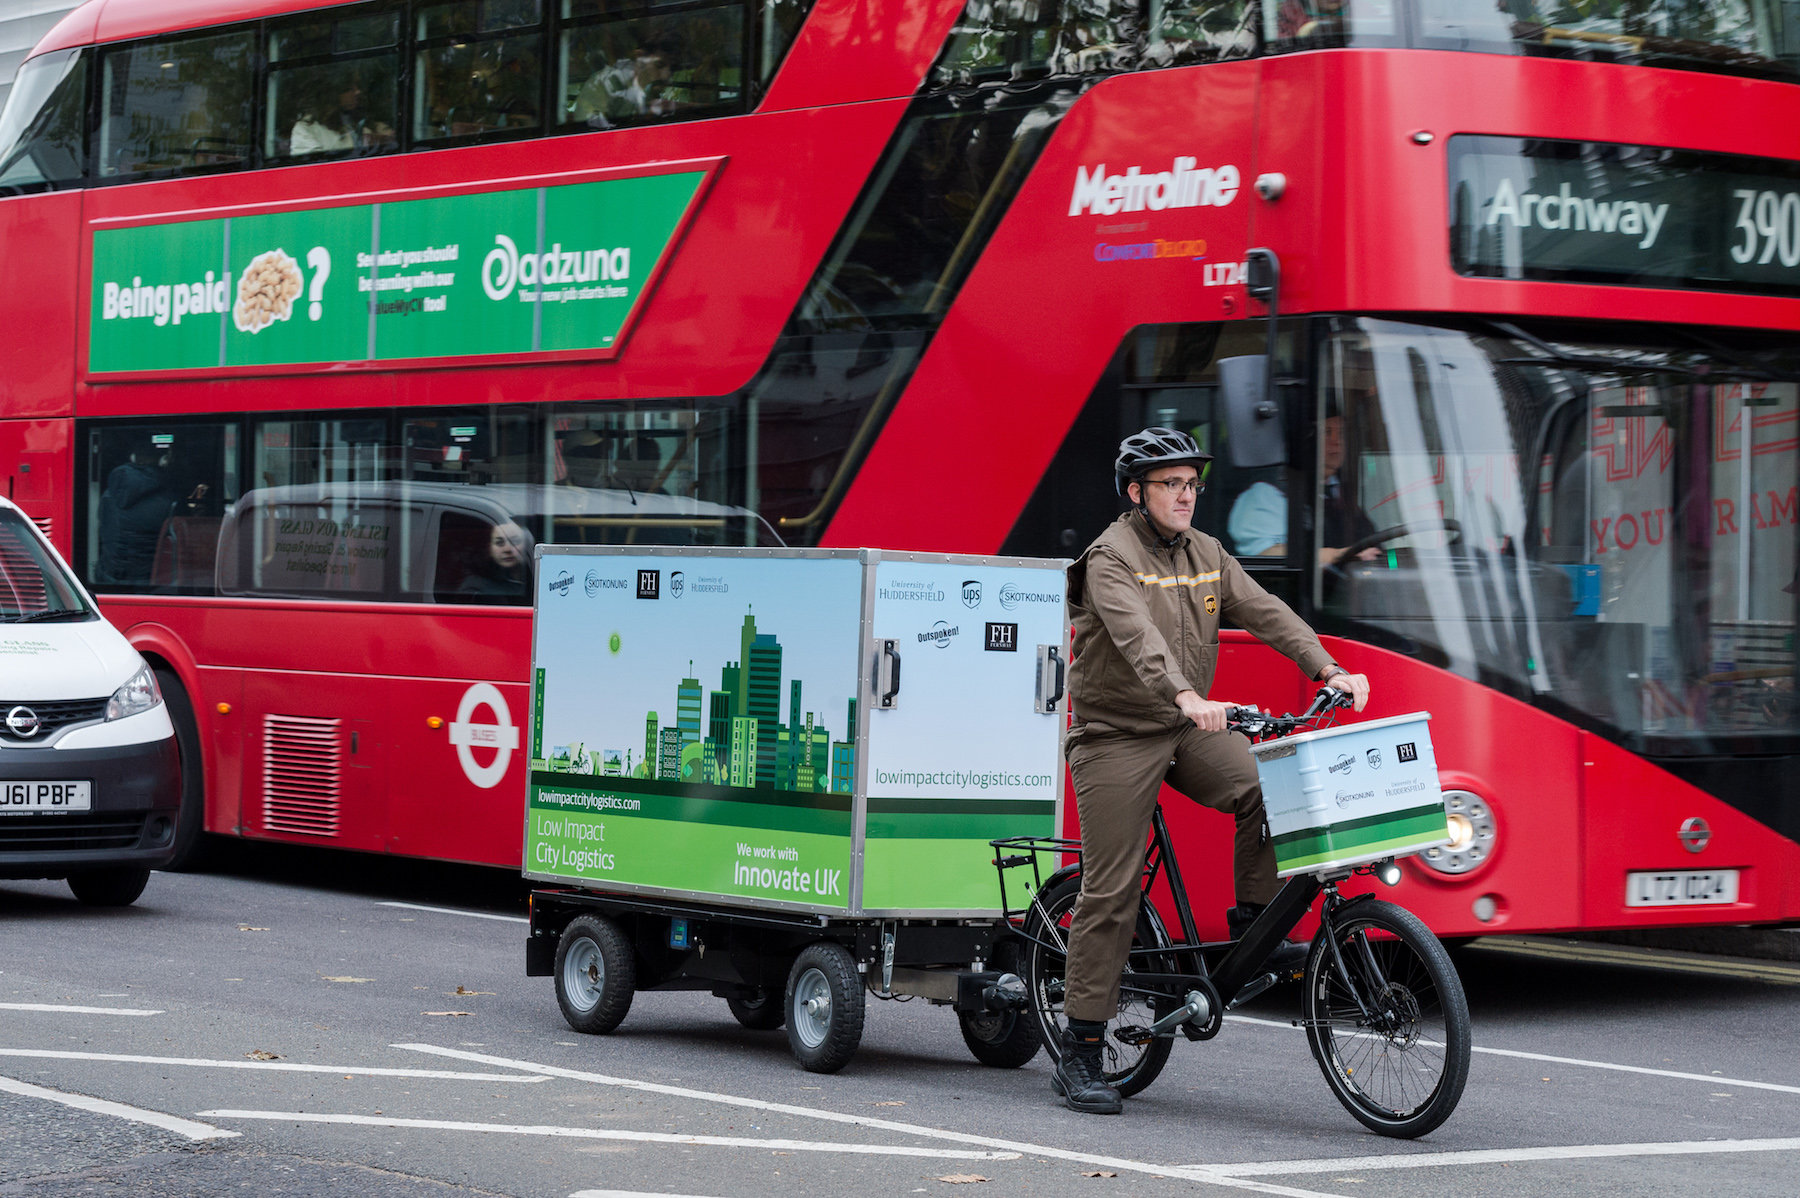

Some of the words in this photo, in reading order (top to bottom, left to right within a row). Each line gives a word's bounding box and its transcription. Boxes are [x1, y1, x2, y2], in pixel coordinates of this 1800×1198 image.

[1068, 156, 1240, 216] Metroline
[1486, 178, 1670, 250] Archway
[1730, 189, 1800, 268] 390
[518, 243, 631, 286] adzuna
[306, 246, 331, 322] ?
[103, 276, 171, 327] Being
[171, 270, 231, 325] paid
[1591, 506, 1674, 554] YOU
[641, 572, 656, 590] FH
[671, 579, 683, 595] ups
[891, 580, 925, 590] University
[926, 581, 935, 591] of
[879, 588, 945, 602] HUDDERSFIELD
[963, 589, 980, 604] ups
[1004, 592, 1061, 604] SKOTKONUNG
[917, 626, 960, 643] Outspoken!
[990, 625, 1013, 643] FH
[1368, 754, 1381, 766] ups
[1399, 744, 1414, 758] FH
[875, 768, 1052, 789] lowimpactcitylogistics.com
[37, 784, 77, 805] PBF
[537, 788, 641, 811] lowimpactcitylogistics.com
[537, 815, 562, 838] Low
[564, 817, 605, 844] Impact
[535, 841, 560, 869] City
[562, 844, 615, 872] Logistics
[736, 842, 752, 857] We
[753, 843, 776, 859] work
[777, 846, 799, 862] with
[734, 860, 811, 892] Innovate
[815, 867, 841, 896] UK
